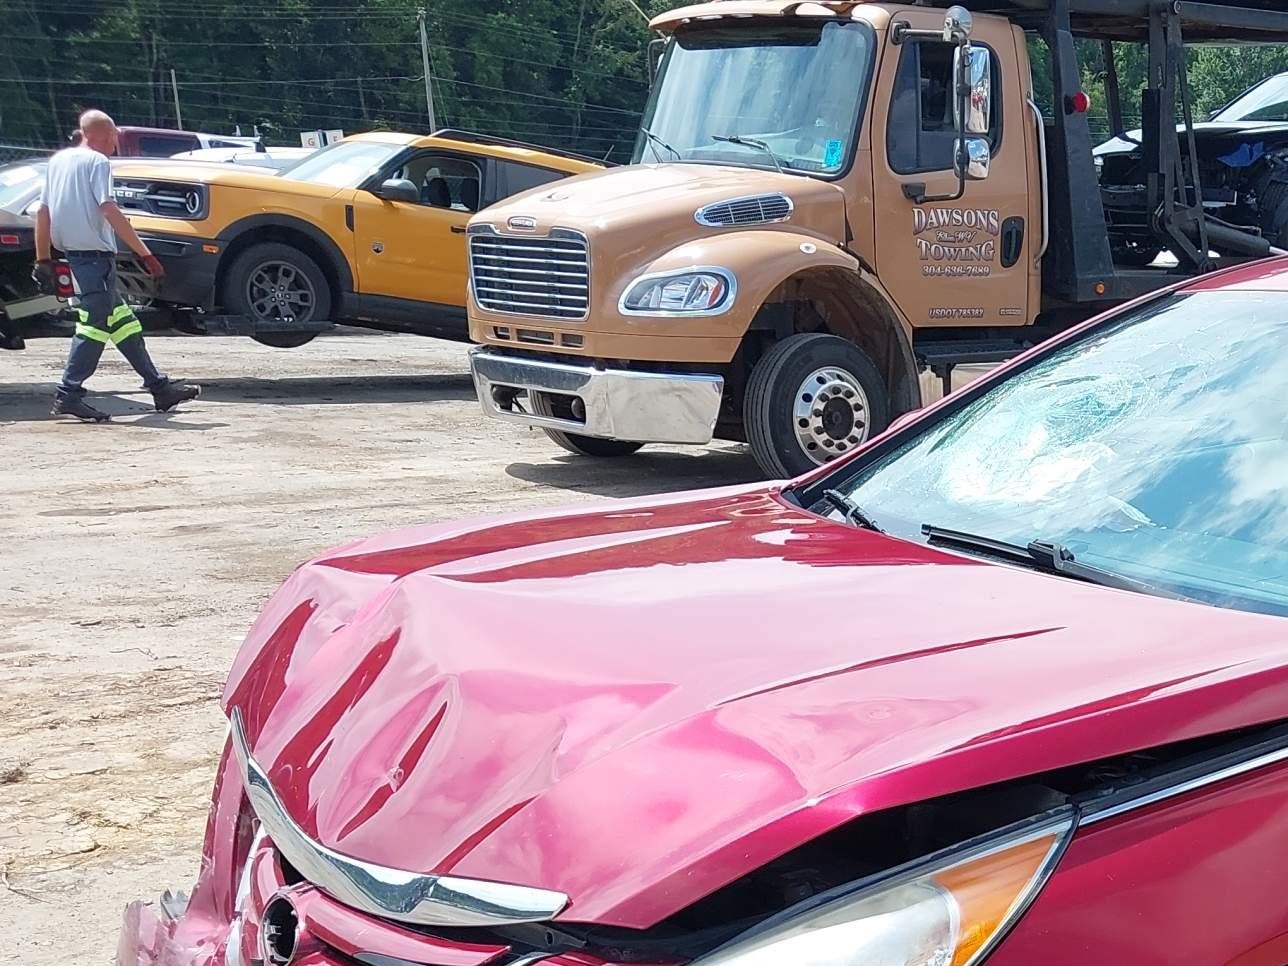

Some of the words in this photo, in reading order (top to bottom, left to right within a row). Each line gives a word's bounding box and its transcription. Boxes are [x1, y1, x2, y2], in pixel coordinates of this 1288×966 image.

[912, 207, 999, 236] DAWSONS
[916, 238, 995, 261] TOWING
[929, 308, 956, 318] USDOT
